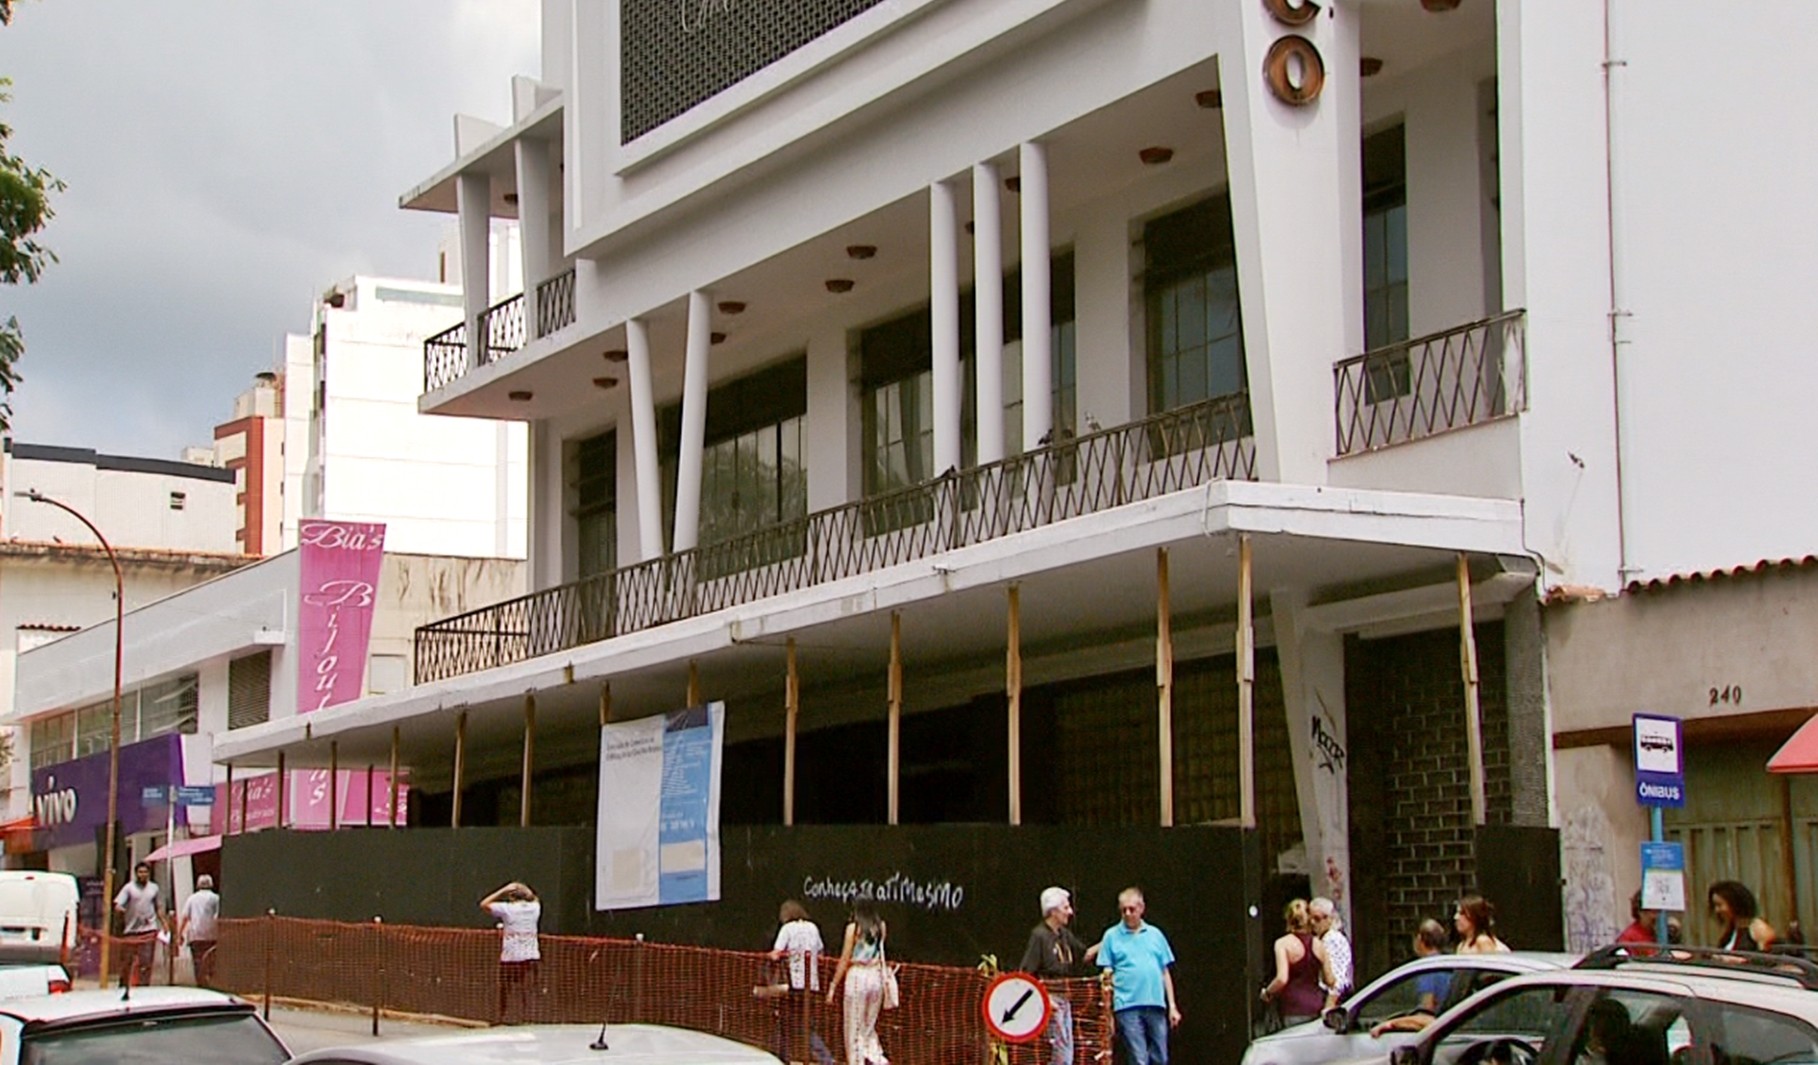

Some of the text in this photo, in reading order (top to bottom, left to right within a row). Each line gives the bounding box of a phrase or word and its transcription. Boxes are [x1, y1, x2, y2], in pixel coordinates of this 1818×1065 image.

[300, 523, 382, 550] Bia's
[1709, 685, 1741, 707] 240
[36, 775, 77, 825] vivo
[1639, 782, 1680, 800] ÔNIBUS
